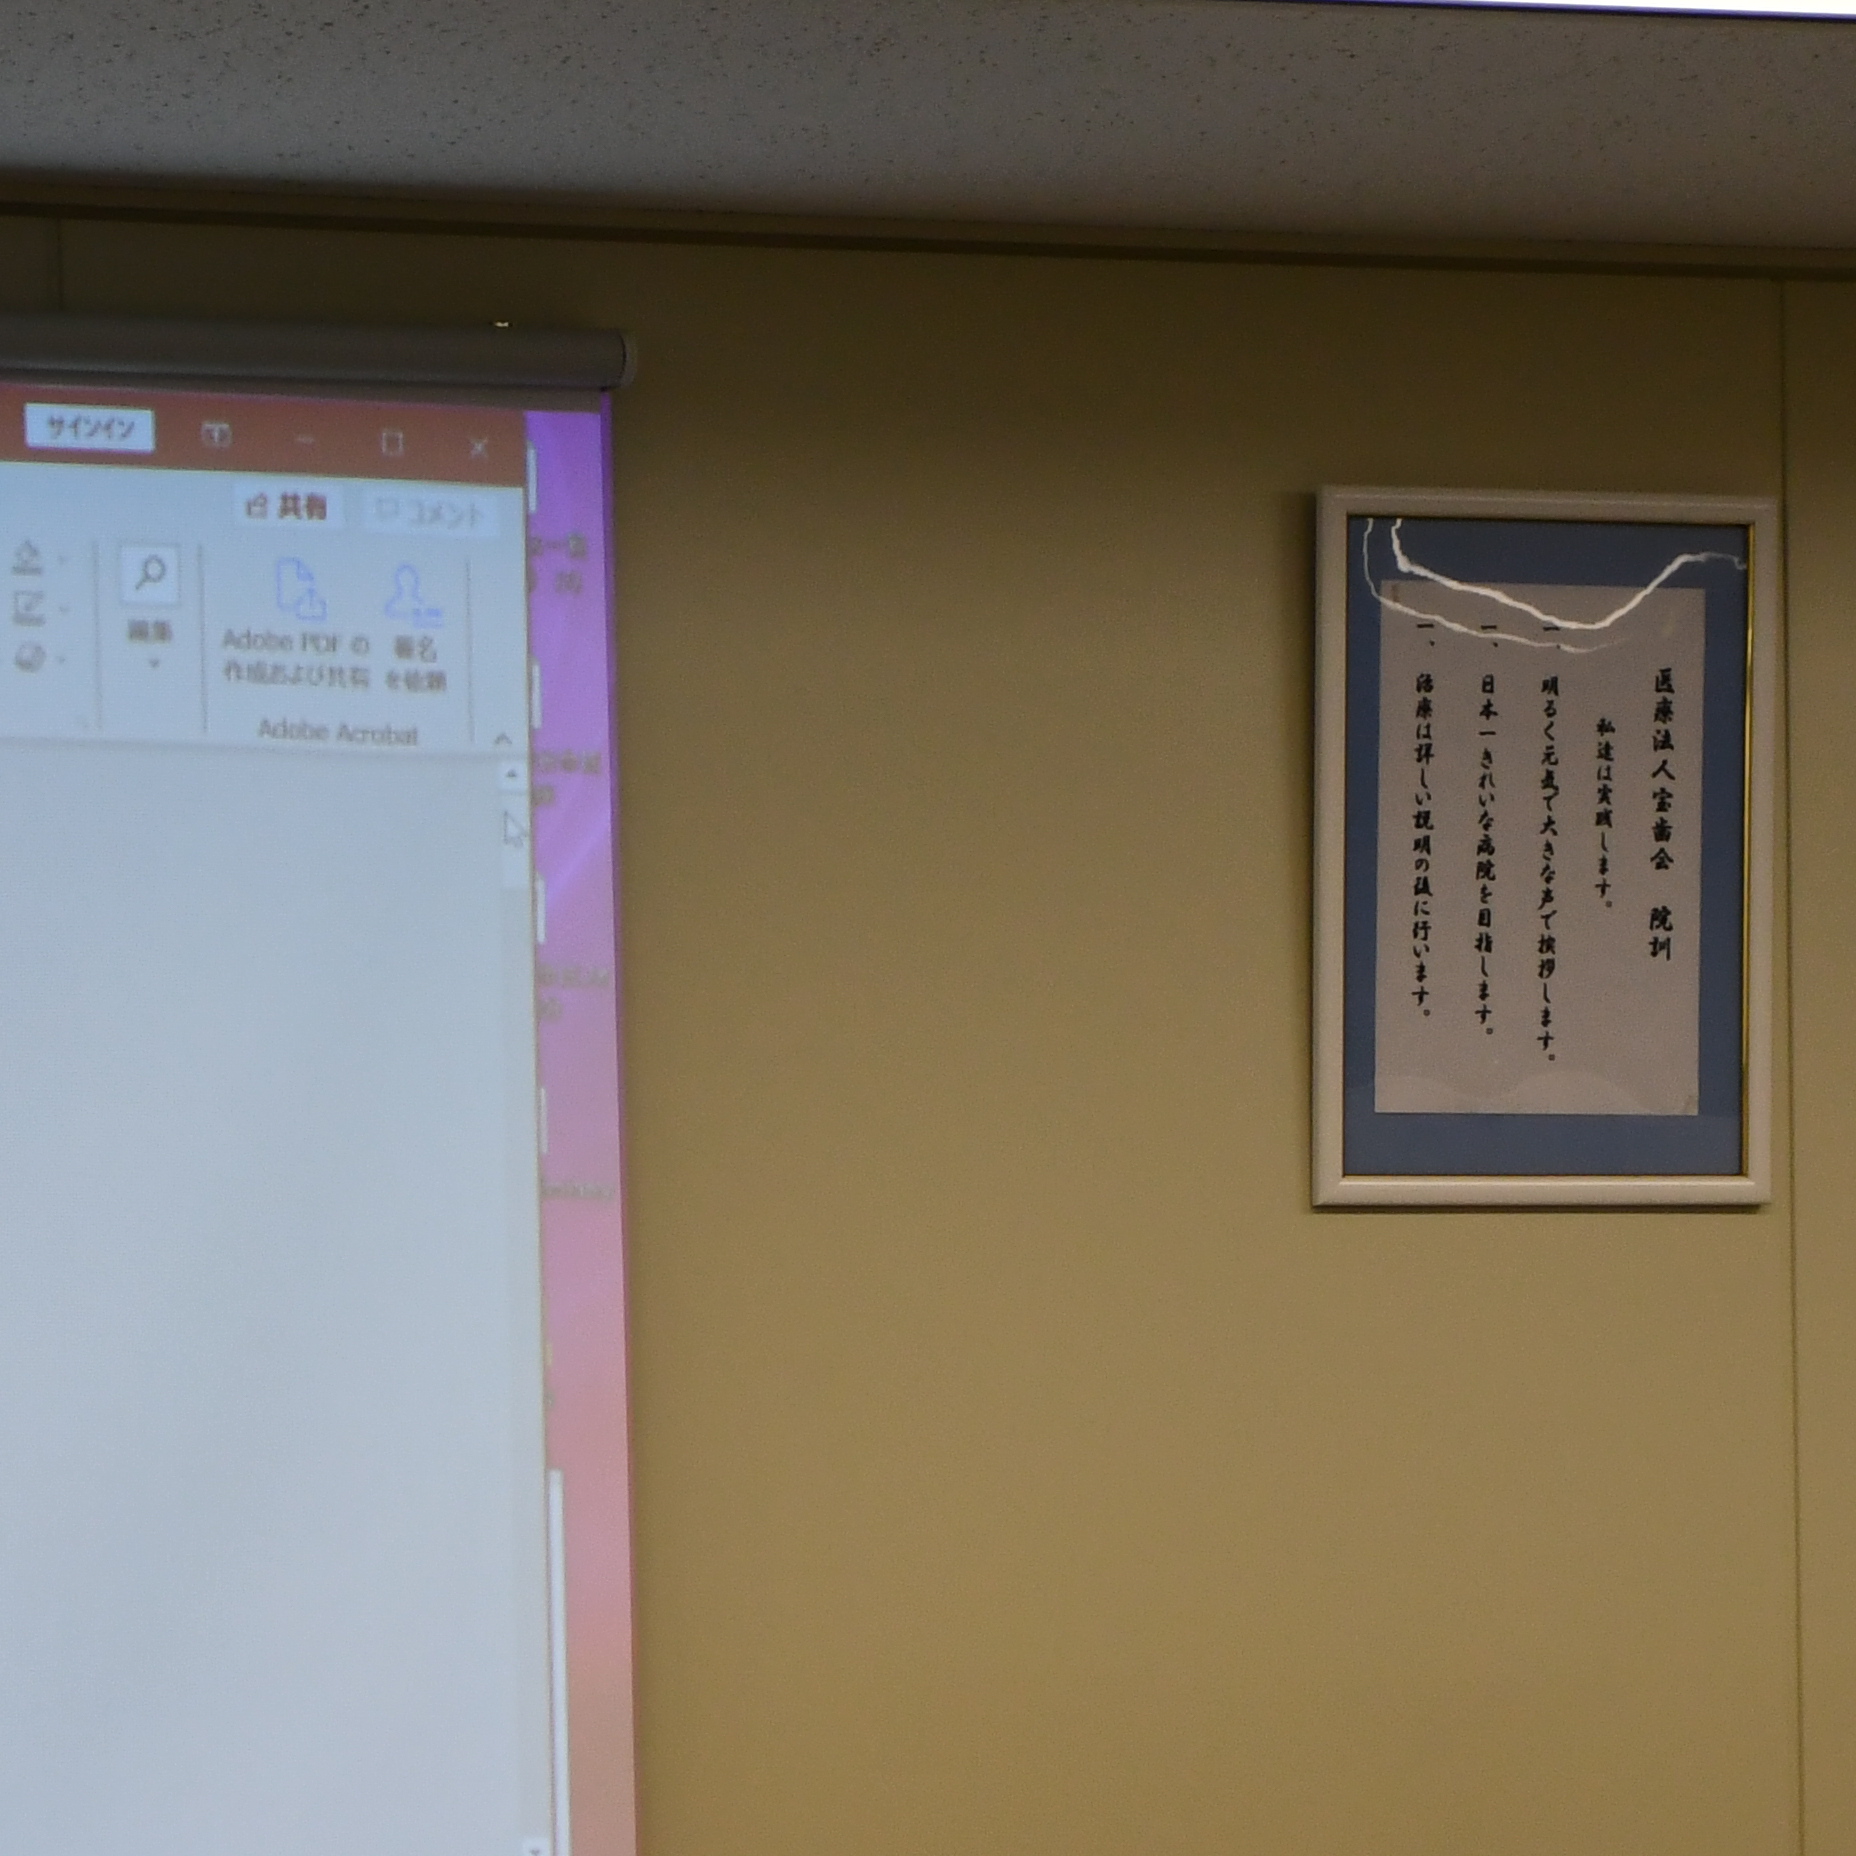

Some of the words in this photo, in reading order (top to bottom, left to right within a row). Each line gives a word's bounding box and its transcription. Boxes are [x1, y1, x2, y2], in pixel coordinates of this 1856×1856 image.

[46, 414, 136, 440] サインイン
[223, 627, 292, 652] Adobe
[257, 717, 330, 742] Adobe
[336, 722, 419, 747] Acrobat
